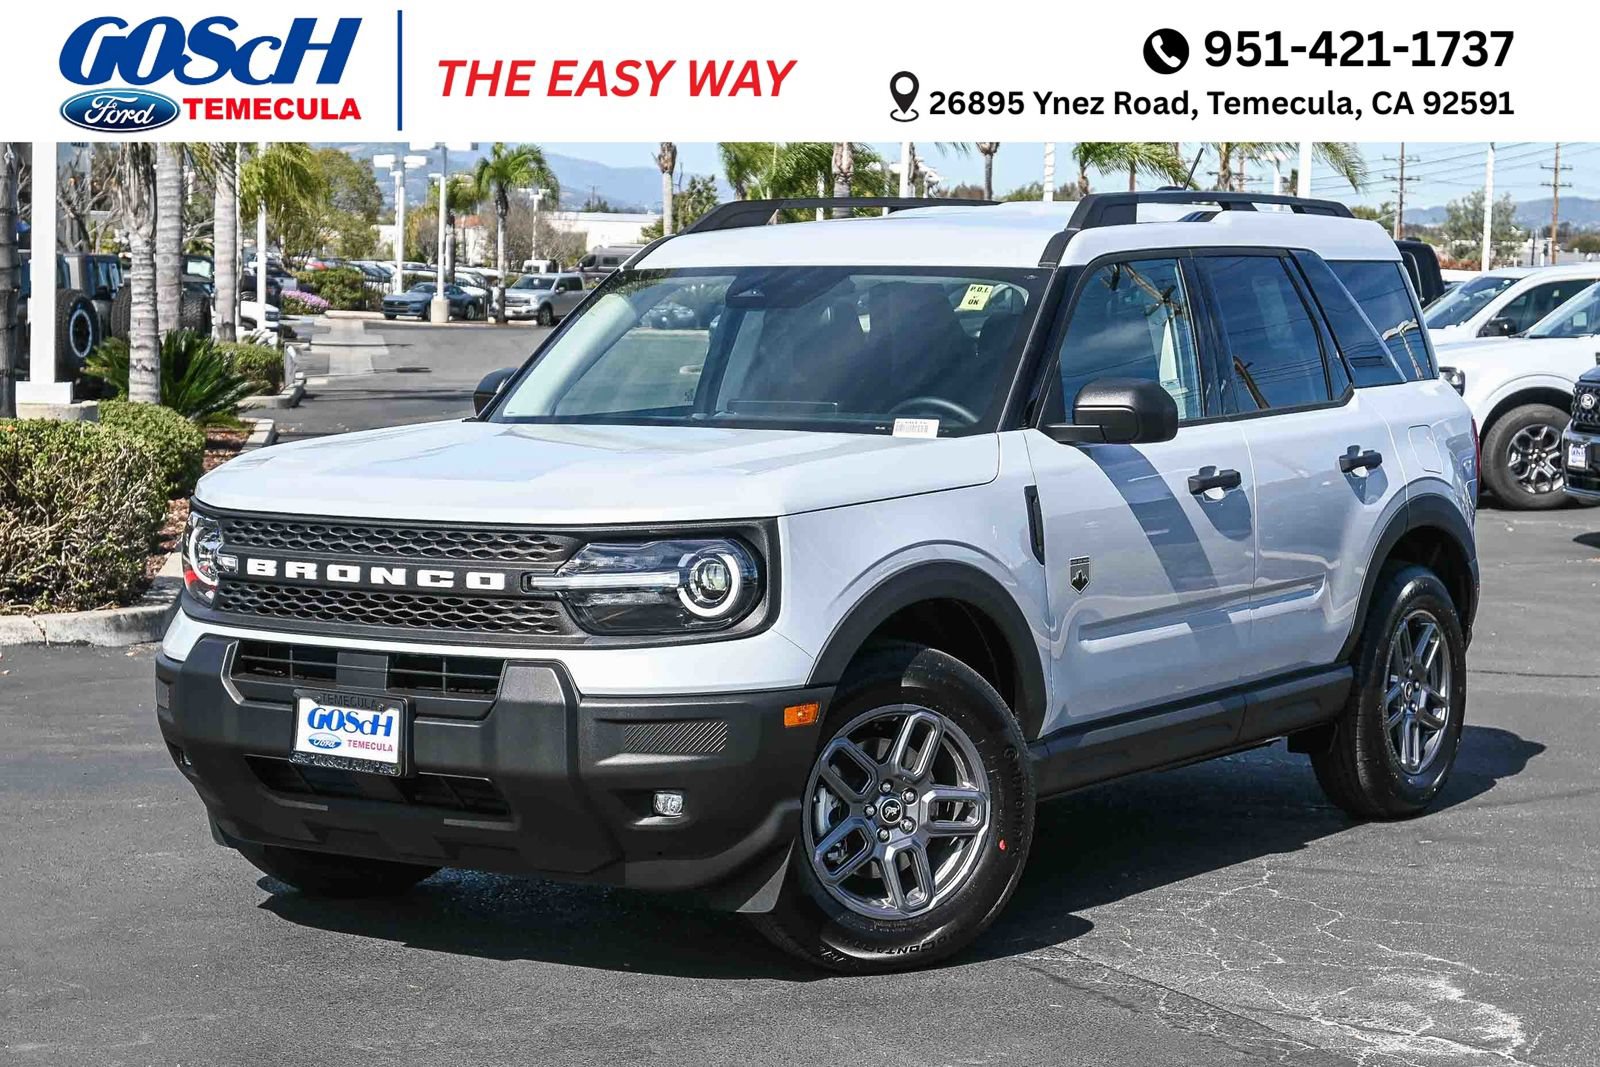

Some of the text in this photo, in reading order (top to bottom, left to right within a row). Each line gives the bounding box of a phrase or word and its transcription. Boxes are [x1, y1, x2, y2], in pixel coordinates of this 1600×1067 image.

[247, 558, 505, 590] BRONCO
[321, 693, 376, 709] TEMECULA
[347, 739, 393, 752] TEMECULA
